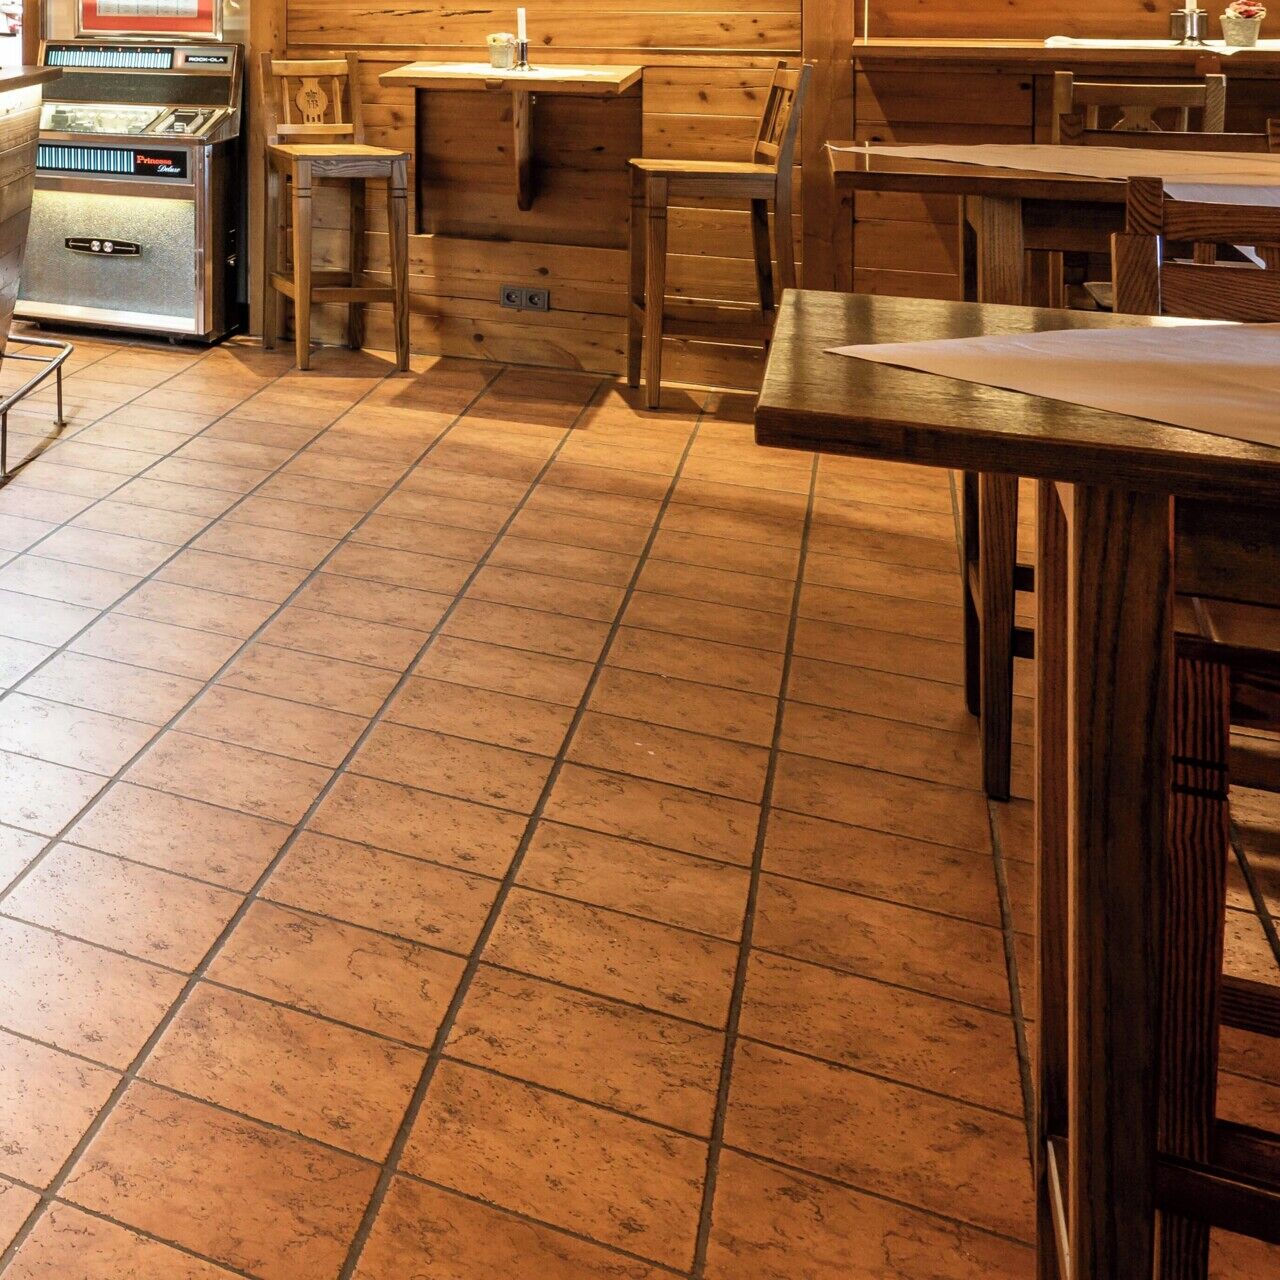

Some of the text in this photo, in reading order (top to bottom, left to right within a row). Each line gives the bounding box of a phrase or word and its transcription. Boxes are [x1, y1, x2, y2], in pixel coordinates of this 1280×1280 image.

[188, 56, 225, 64] ROCK-OLA
[136, 154, 173, 165] Princess
[157, 164, 182, 173] Deluxe
